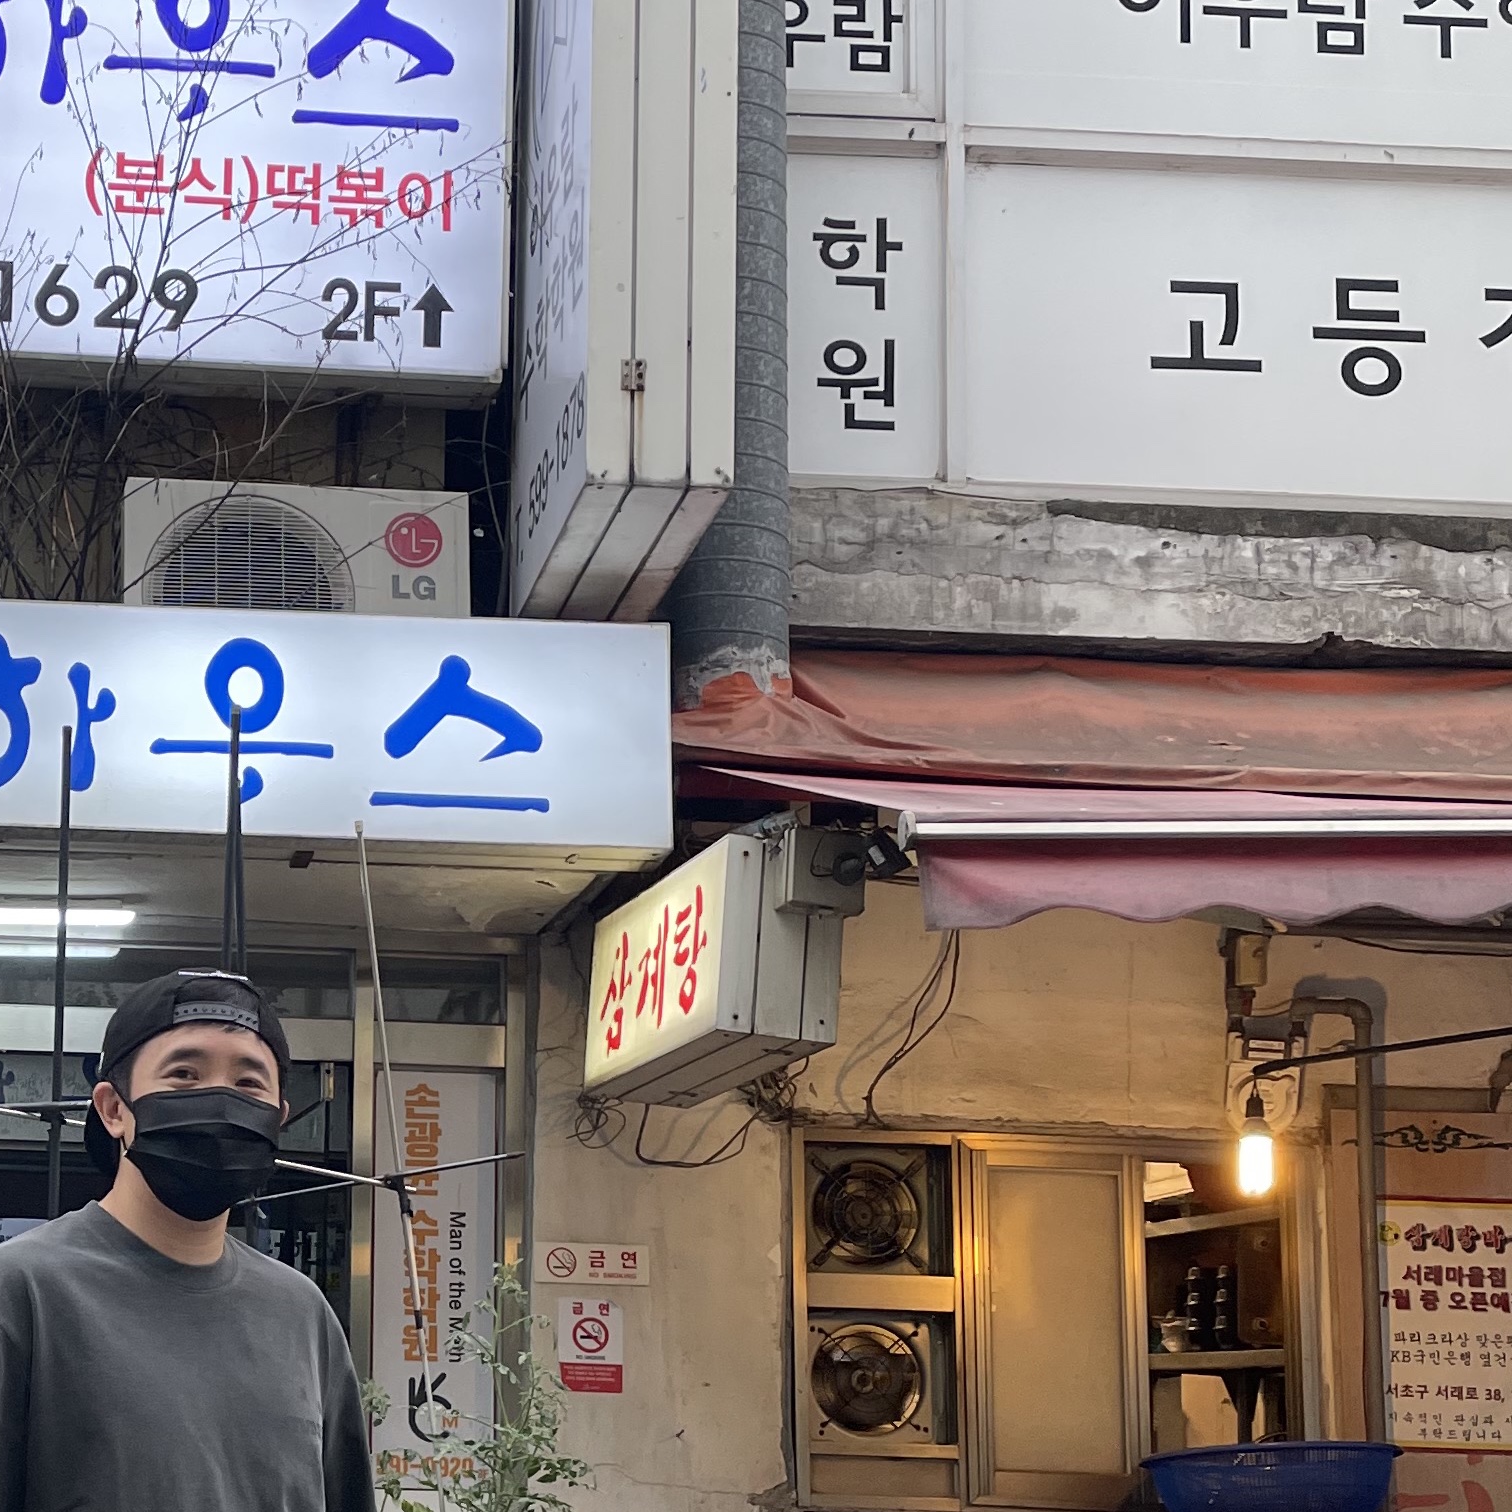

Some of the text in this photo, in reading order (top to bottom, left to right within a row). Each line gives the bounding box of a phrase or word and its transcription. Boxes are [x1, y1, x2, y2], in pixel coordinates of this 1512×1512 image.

[321, 277, 402, 342] 2F
[527, 371, 585, 540] 599-1878
[391, 574, 436, 600] LG
[601, 885, 708, 1056] 삼계탕
[449, 1211, 466, 1250] Man
[449, 1257, 466, 1276] of
[449, 1281, 466, 1310] the
[1394, 1331, 1469, 1348] 파리크라상
[1391, 1350, 1471, 1367] KB국민은행
[1385, 1383, 1505, 1403] 서초구 서래로 38,
